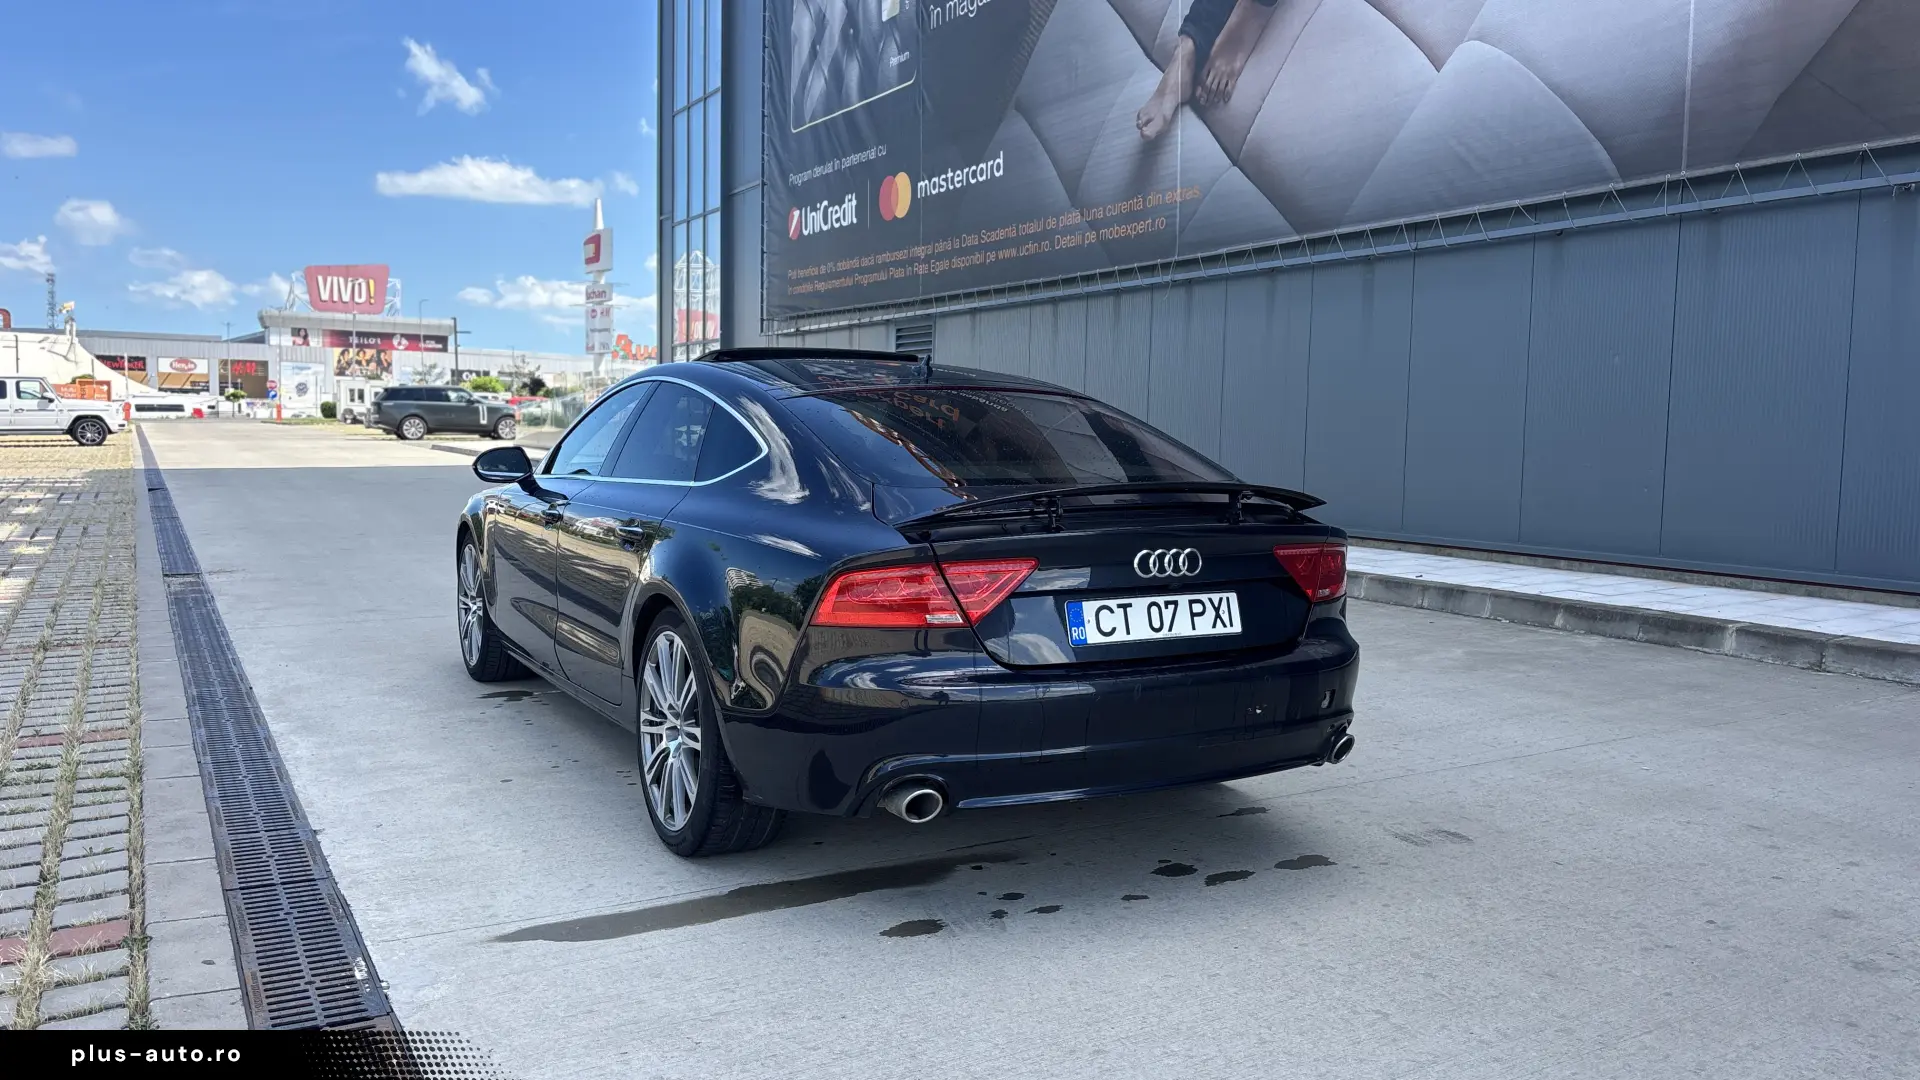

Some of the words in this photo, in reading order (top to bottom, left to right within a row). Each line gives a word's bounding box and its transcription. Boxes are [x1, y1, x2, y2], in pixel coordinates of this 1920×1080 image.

[929, 4, 942, 30] în
[889, 51, 910, 68] Premium
[788, 169, 813, 187] Program
[812, 160, 833, 178] derulat
[841, 146, 877, 172] parteneriat
[877, 143, 887, 157] cu
[917, 150, 1004, 199] mastercard
[801, 191, 858, 237] UniCredit
[819, 265, 827, 275] de
[827, 261, 836, 274] 0%
[860, 253, 875, 267] dacă
[875, 246, 909, 264] rambursezi
[909, 241, 934, 260] integral
[934, 237, 952, 255] până
[953, 236, 960, 249] la
[961, 234, 979, 248] Data
[1019, 218, 1044, 236] totalul
[1045, 215, 1057, 230] de
[1059, 209, 1081, 232] plată
[1083, 207, 1104, 222] luna
[1106, 195, 1143, 217] curentă
[1146, 191, 1162, 208] din
[814, 276, 854, 293] Regulamentului
[854, 271, 887, 286] Programului
[889, 267, 905, 279] Plata
[913, 262, 929, 275] Rate
[930, 258, 950, 275] Egale
[951, 251, 985, 270] disponibil
[986, 252, 996, 266] pe
[1054, 231, 1083, 250] Detalii
[1084, 231, 1097, 248] pe
[1099, 215, 1166, 241] mobexpert.ro
[317, 274, 375, 305] VIVO!
[1071, 626, 1086, 641] RO
[1094, 602, 1133, 637] CT
[1146, 600, 1179, 634] 07
[1188, 596, 1234, 631] PXI
